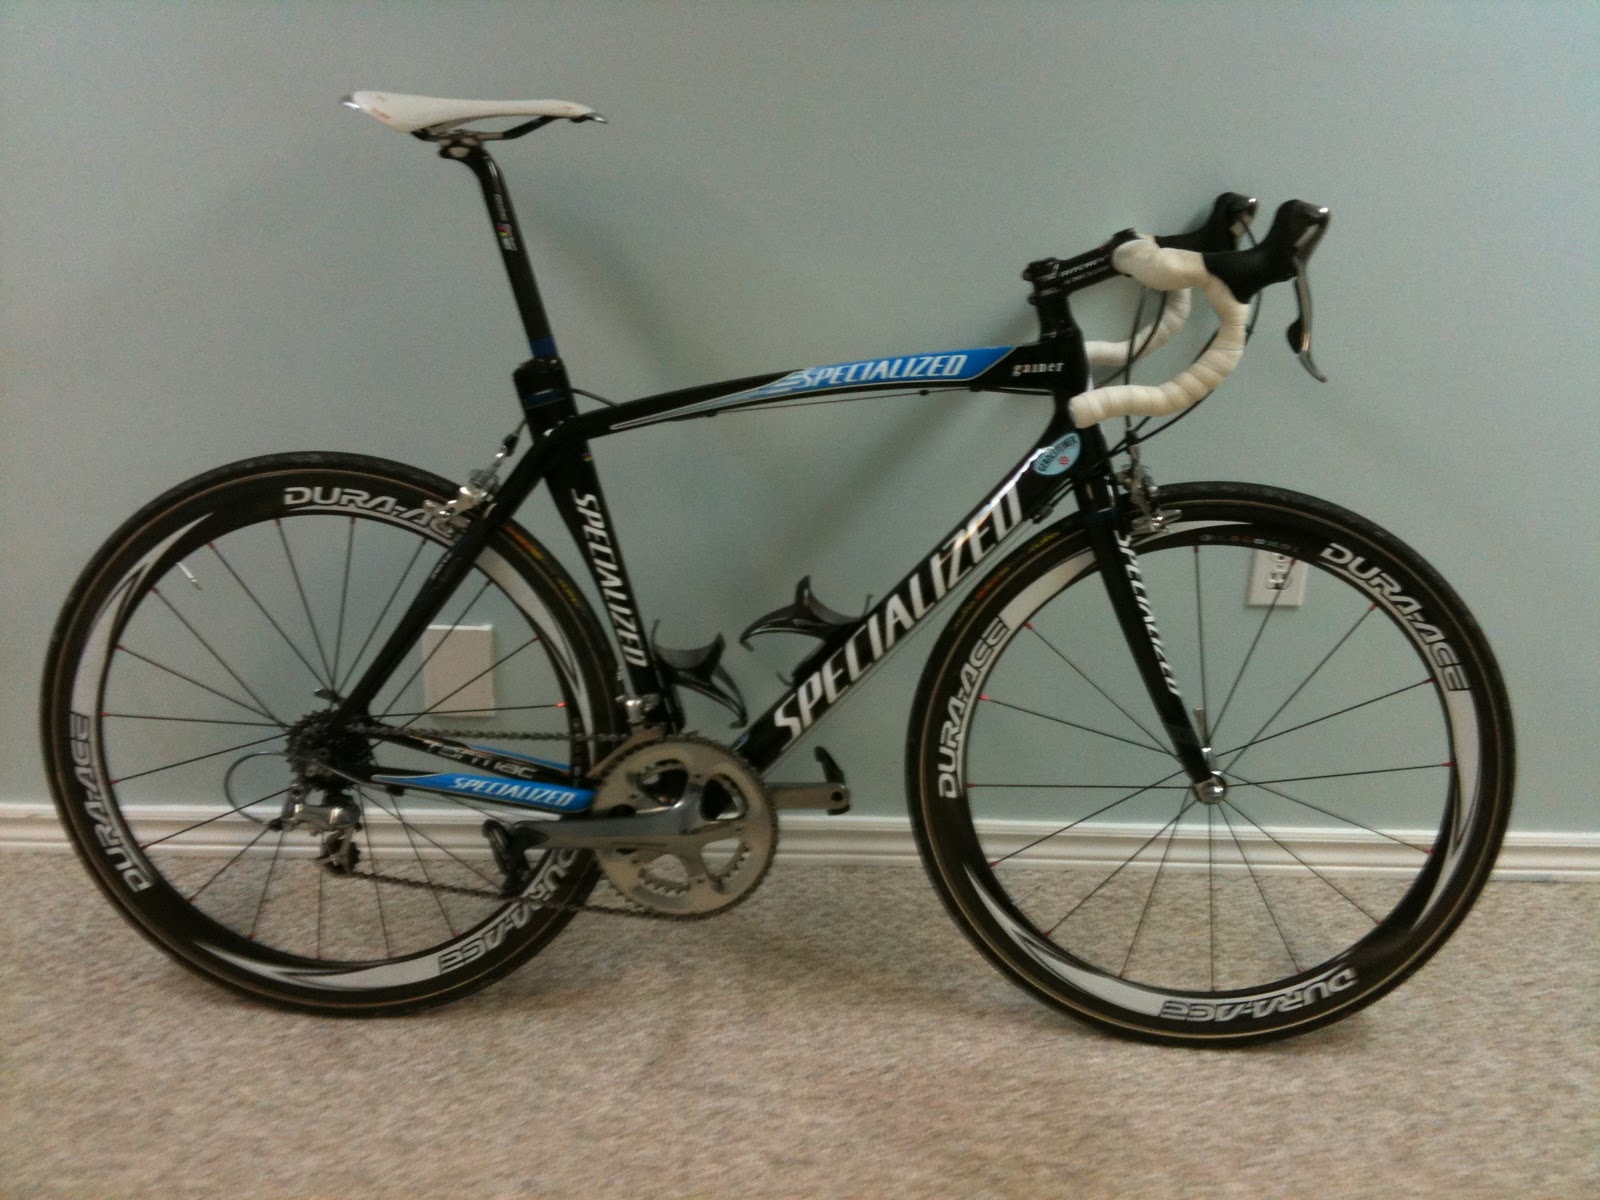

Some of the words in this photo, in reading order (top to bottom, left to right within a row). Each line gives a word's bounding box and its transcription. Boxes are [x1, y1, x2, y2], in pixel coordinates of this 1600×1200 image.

[801, 354, 969, 386] SPECIALIZED
[284, 486, 469, 543] DURA-AC
[572, 488, 648, 667] SPECIALIZED
[774, 485, 1021, 743] SPECIALIZED
[1319, 543, 1470, 691] DURA-ACE
[938, 615, 1008, 798] DURA-ACE
[69, 711, 152, 893] DURA-ACE
[453, 777, 576, 806] SPECIALIZED
[1161, 967, 1357, 1022] DURA-ACE
